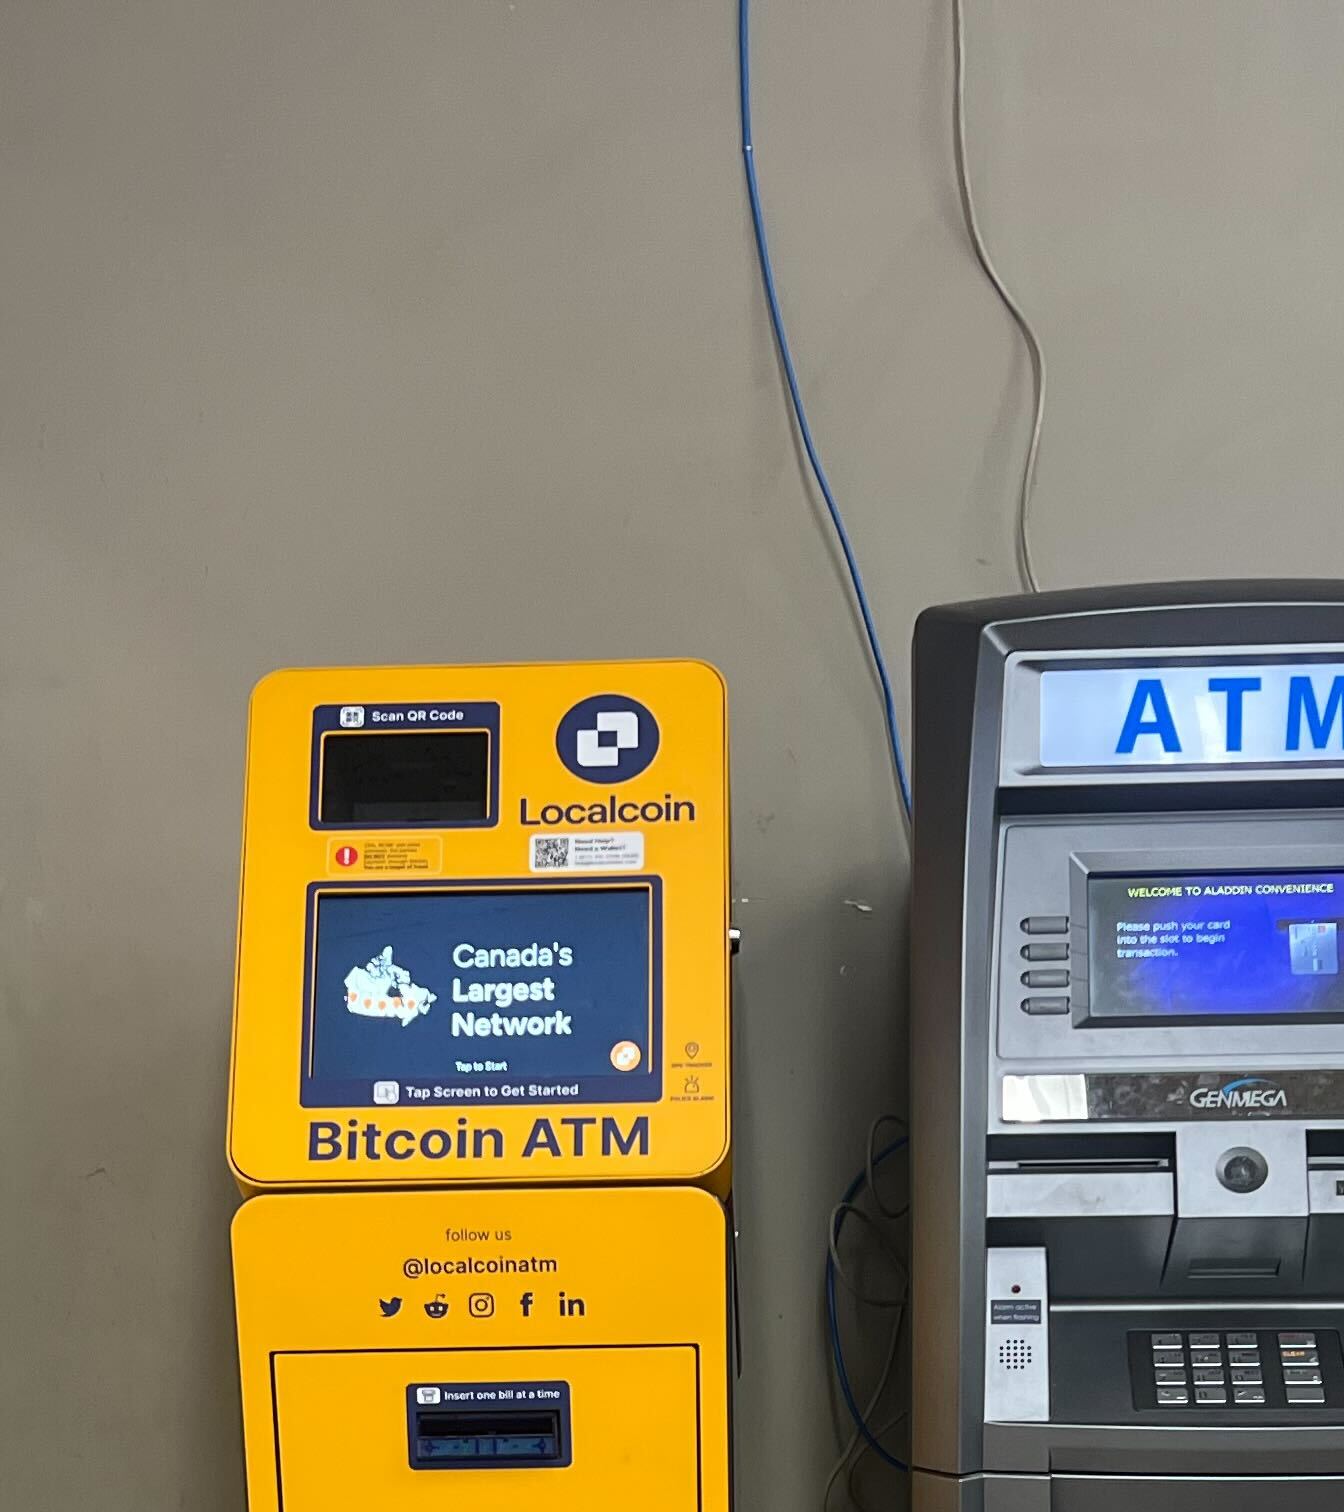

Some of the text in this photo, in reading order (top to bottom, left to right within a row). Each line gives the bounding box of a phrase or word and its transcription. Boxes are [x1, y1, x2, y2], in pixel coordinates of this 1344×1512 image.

[372, 708, 464, 722] Scan QR Code
[521, 794, 695, 825] Localcoin
[1128, 883, 1334, 898] WELCOME TO ALADDIN CONVENIENCE
[1117, 920, 1231, 933] Please push your card
[1117, 933, 1225, 945] into the slot to begin
[452, 942, 573, 969] Canada's
[452, 977, 555, 1008] Largest
[452, 1010, 572, 1038] Network
[455, 1060, 507, 1073] Tap to Start
[406, 1084, 578, 1100] Tap Screen to Get Started
[1189, 1088, 1287, 1109] GENMEGA
[308, 1116, 650, 1161] Bitcoin ATM
[446, 1228, 512, 1242] follow us
[403, 1256, 557, 1279] @localcoinatm
[444, 1391, 474, 1400] Insert
[477, 1392, 496, 1400] one
[498, 1390, 514, 1399] bill
[516, 1391, 527, 1399] at
[537, 1390, 560, 1399] time
